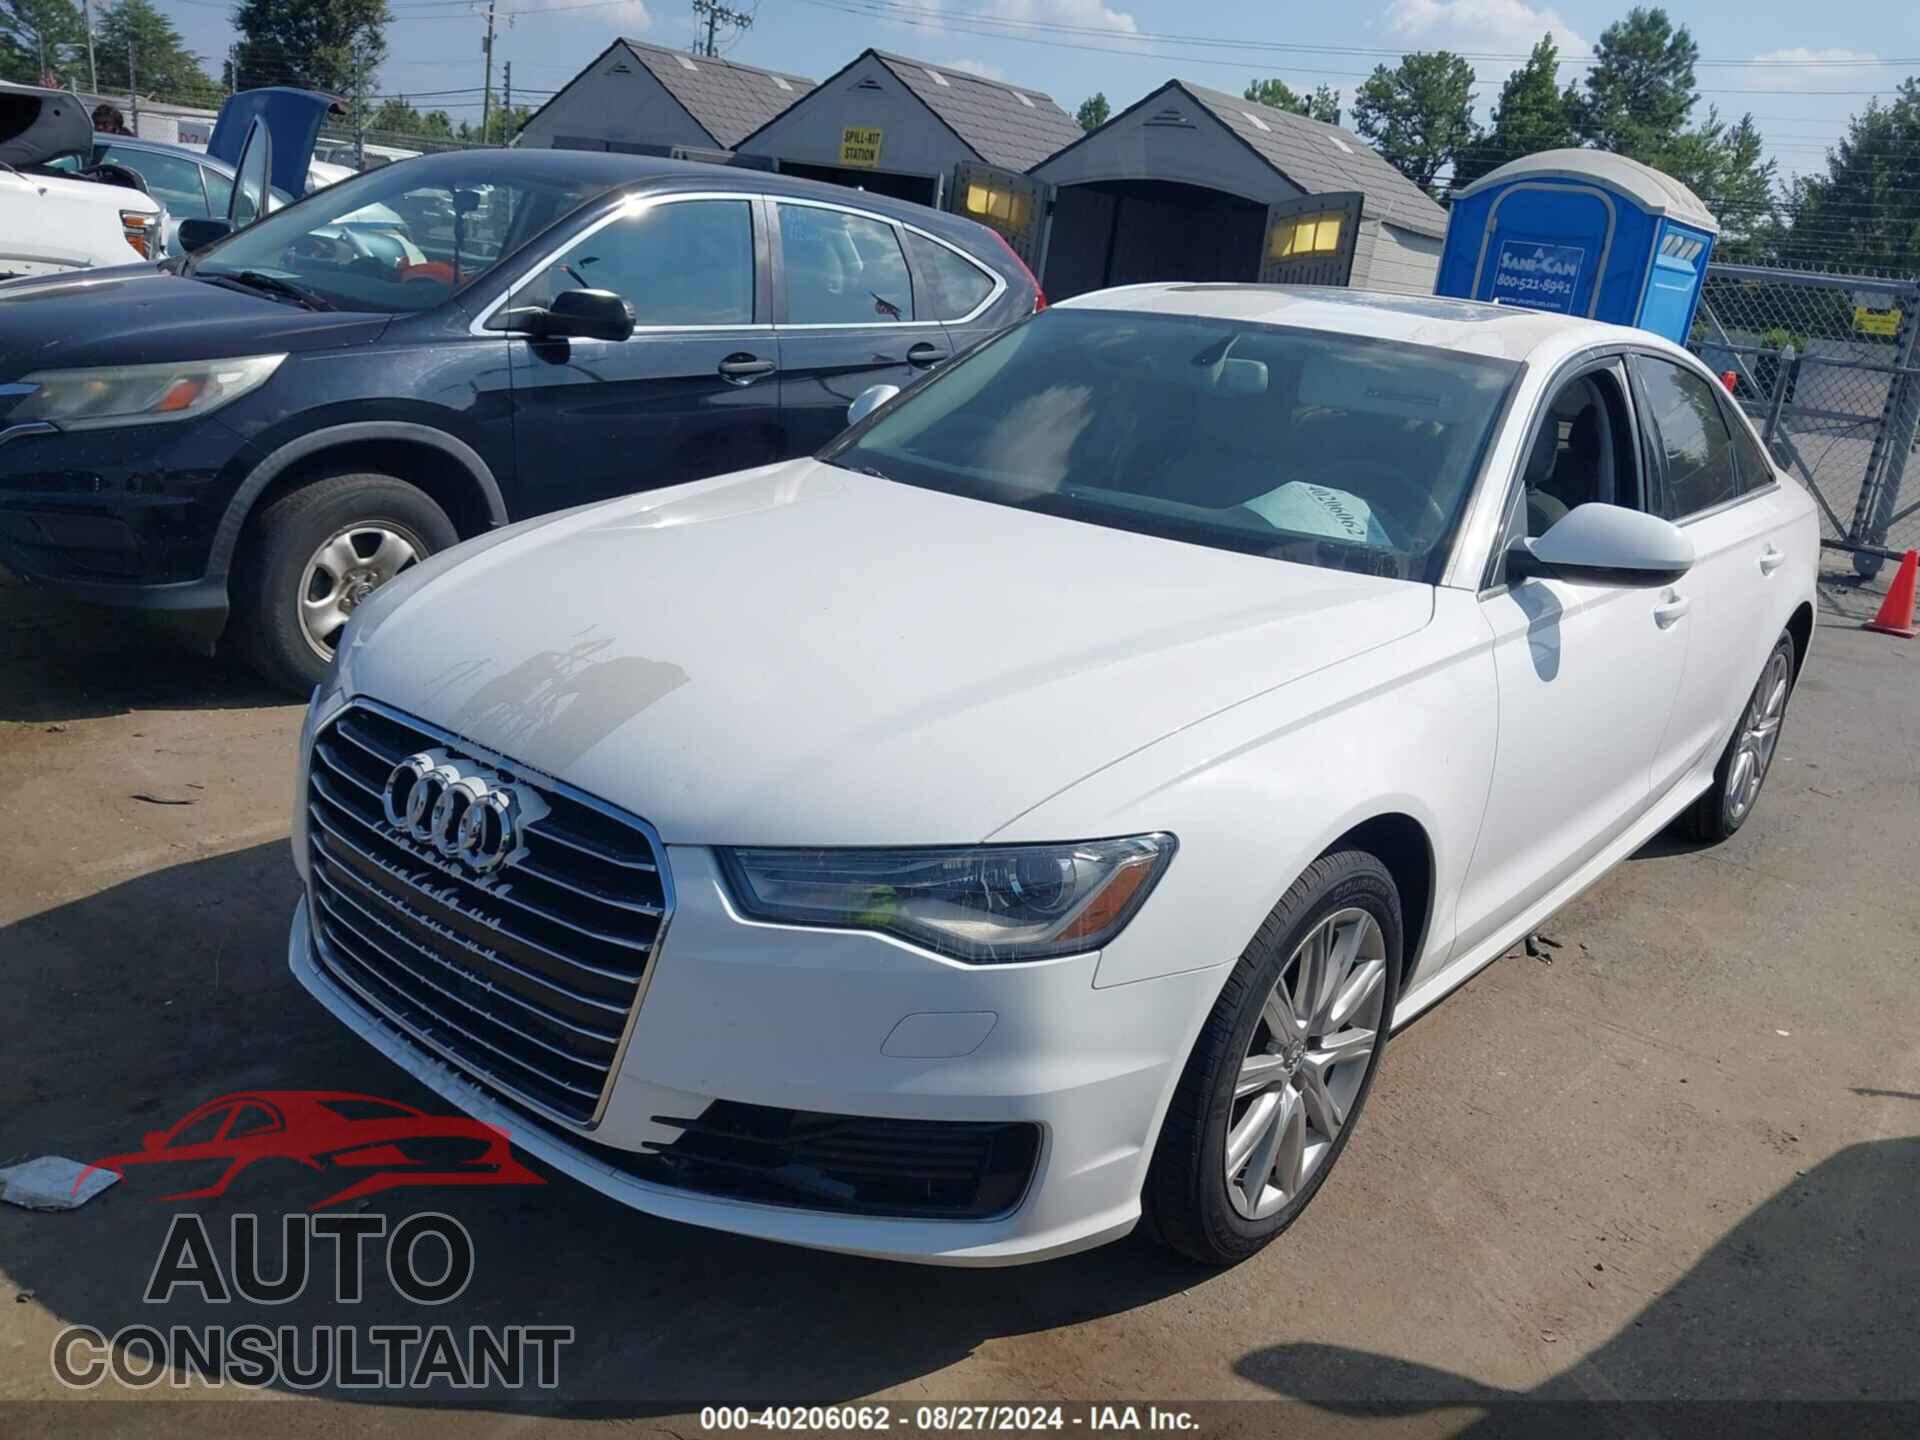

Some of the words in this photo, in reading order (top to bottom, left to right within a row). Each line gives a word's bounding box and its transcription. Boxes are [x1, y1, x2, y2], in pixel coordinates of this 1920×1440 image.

[844, 130, 880, 145] SPILL-KIT
[844, 146, 875, 161] STATION
[1502, 252, 1577, 276] SANI-CAN
[1308, 485, 1366, 536] 40206062
